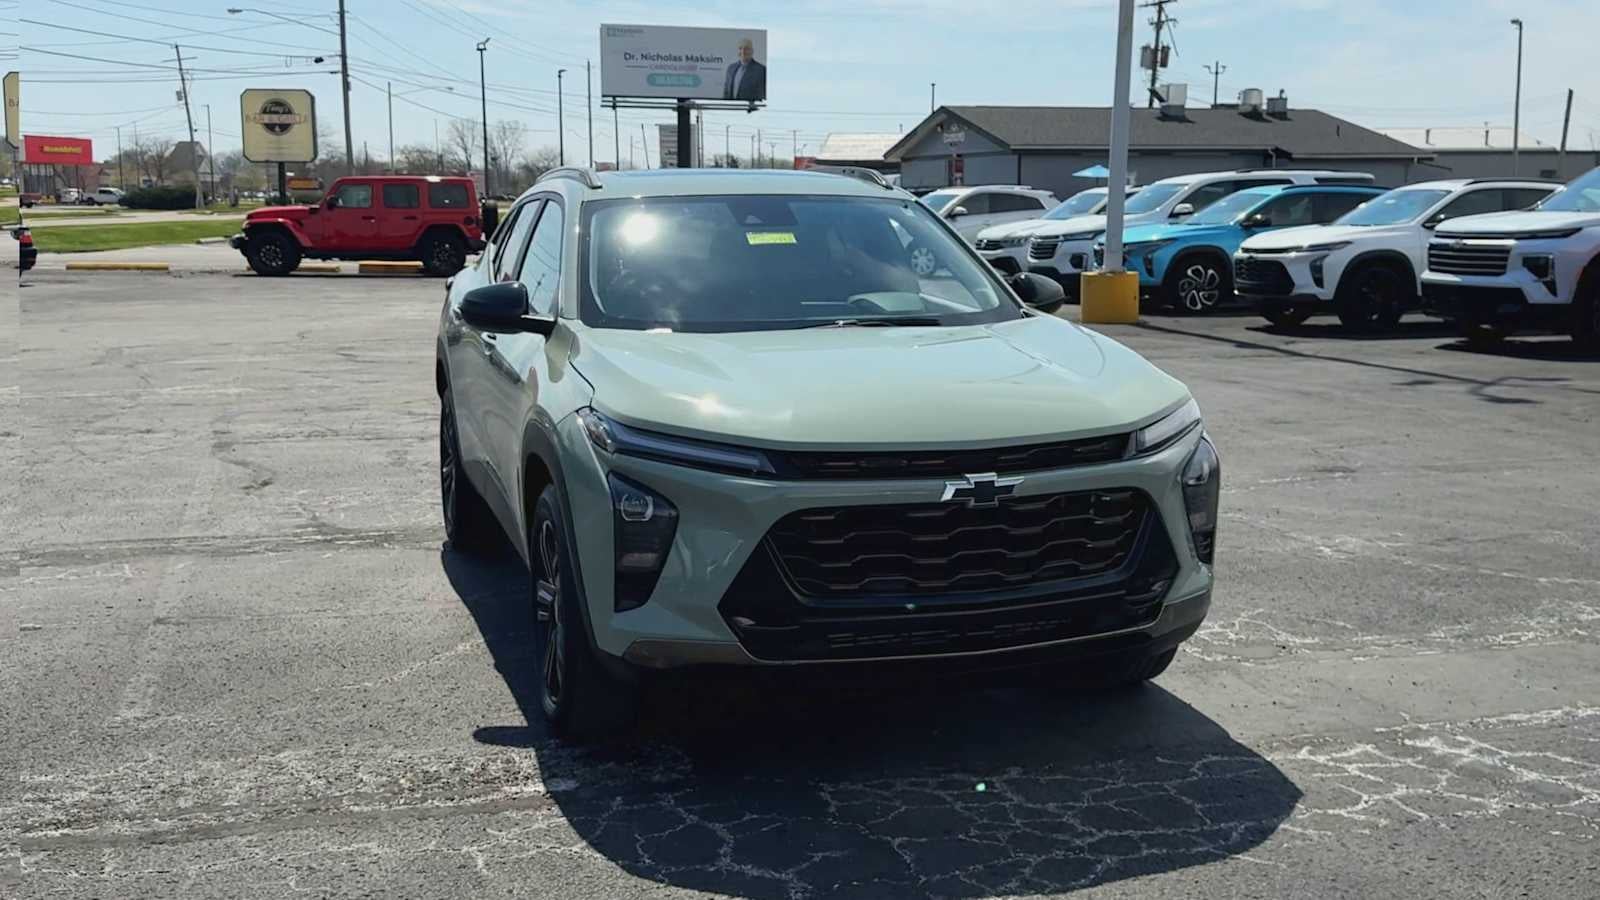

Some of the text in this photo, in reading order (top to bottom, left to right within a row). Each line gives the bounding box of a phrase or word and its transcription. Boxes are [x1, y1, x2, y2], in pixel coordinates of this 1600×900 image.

[623, 52, 724, 63] Dr. Nicholas Maksim
